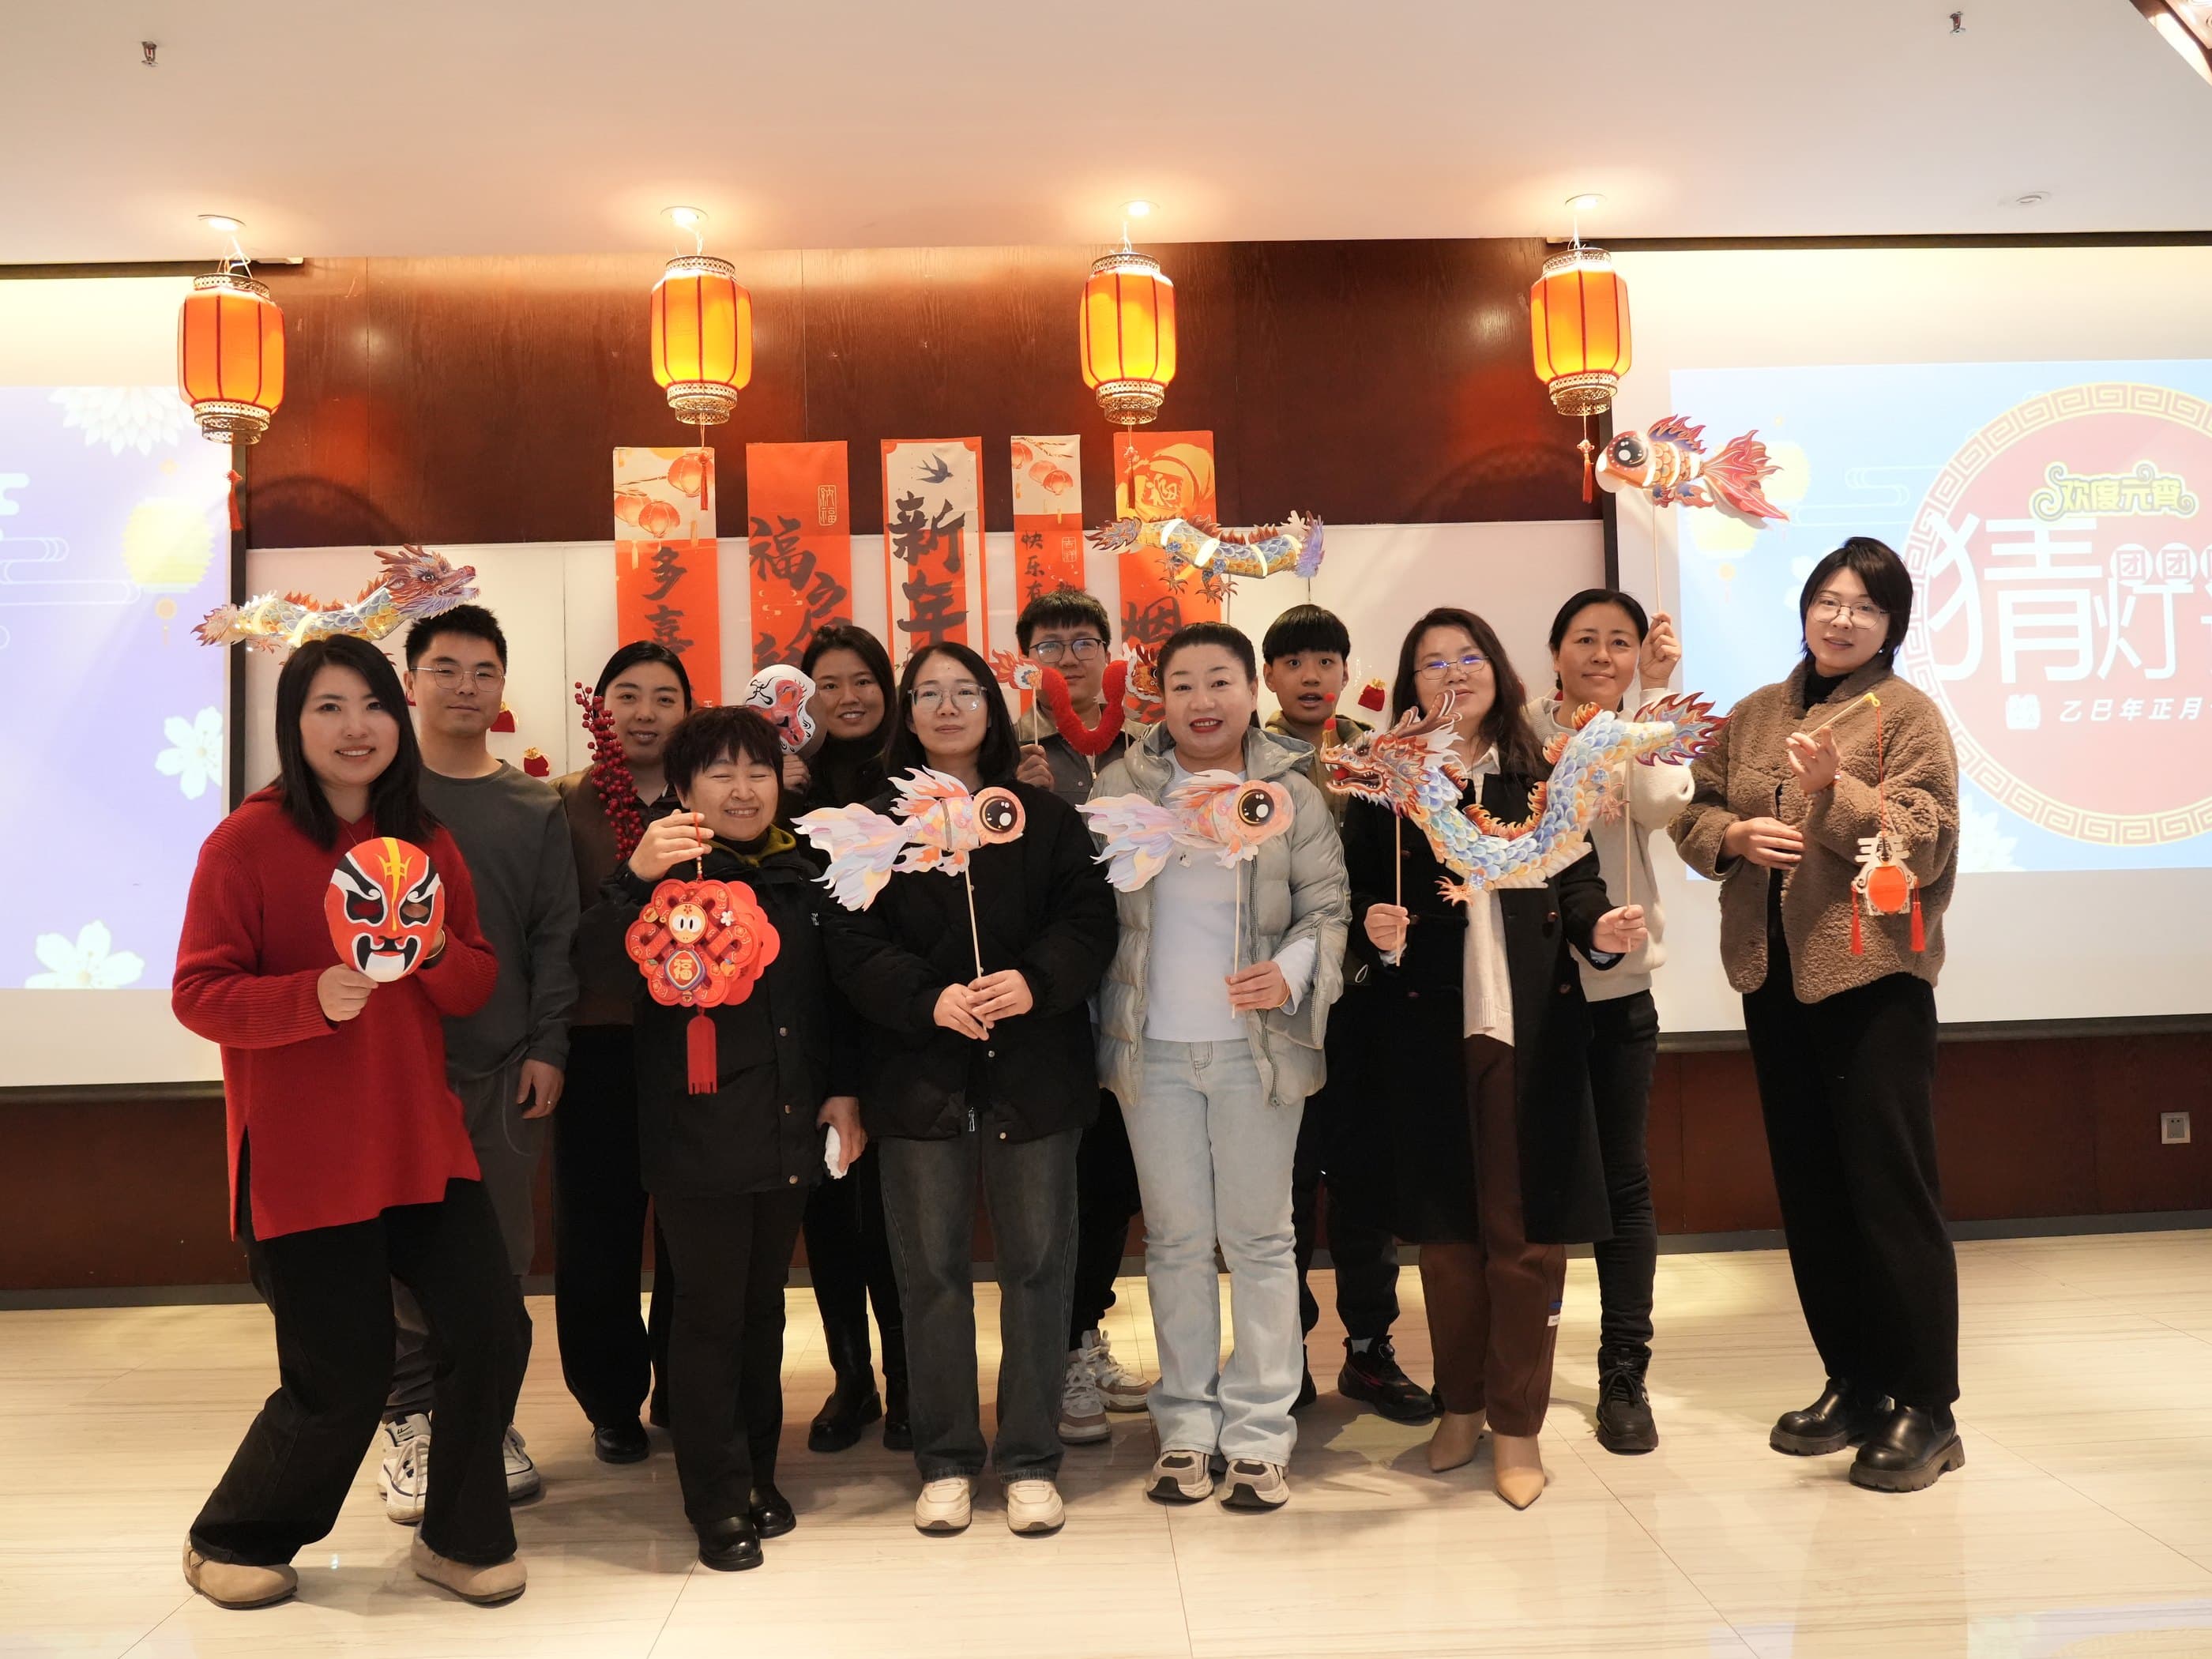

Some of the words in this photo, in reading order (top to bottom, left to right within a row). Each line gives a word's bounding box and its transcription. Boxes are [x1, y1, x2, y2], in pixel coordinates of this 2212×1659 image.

[2048, 472, 2190, 517] 欢度元宵
[886, 491, 969, 645] 新年
[2113, 547, 2212, 582] 团团
[1928, 513, 2212, 684] 猜灯
[2060, 697, 2212, 722] 乙巳年正月
[674, 958, 693, 980] 福
